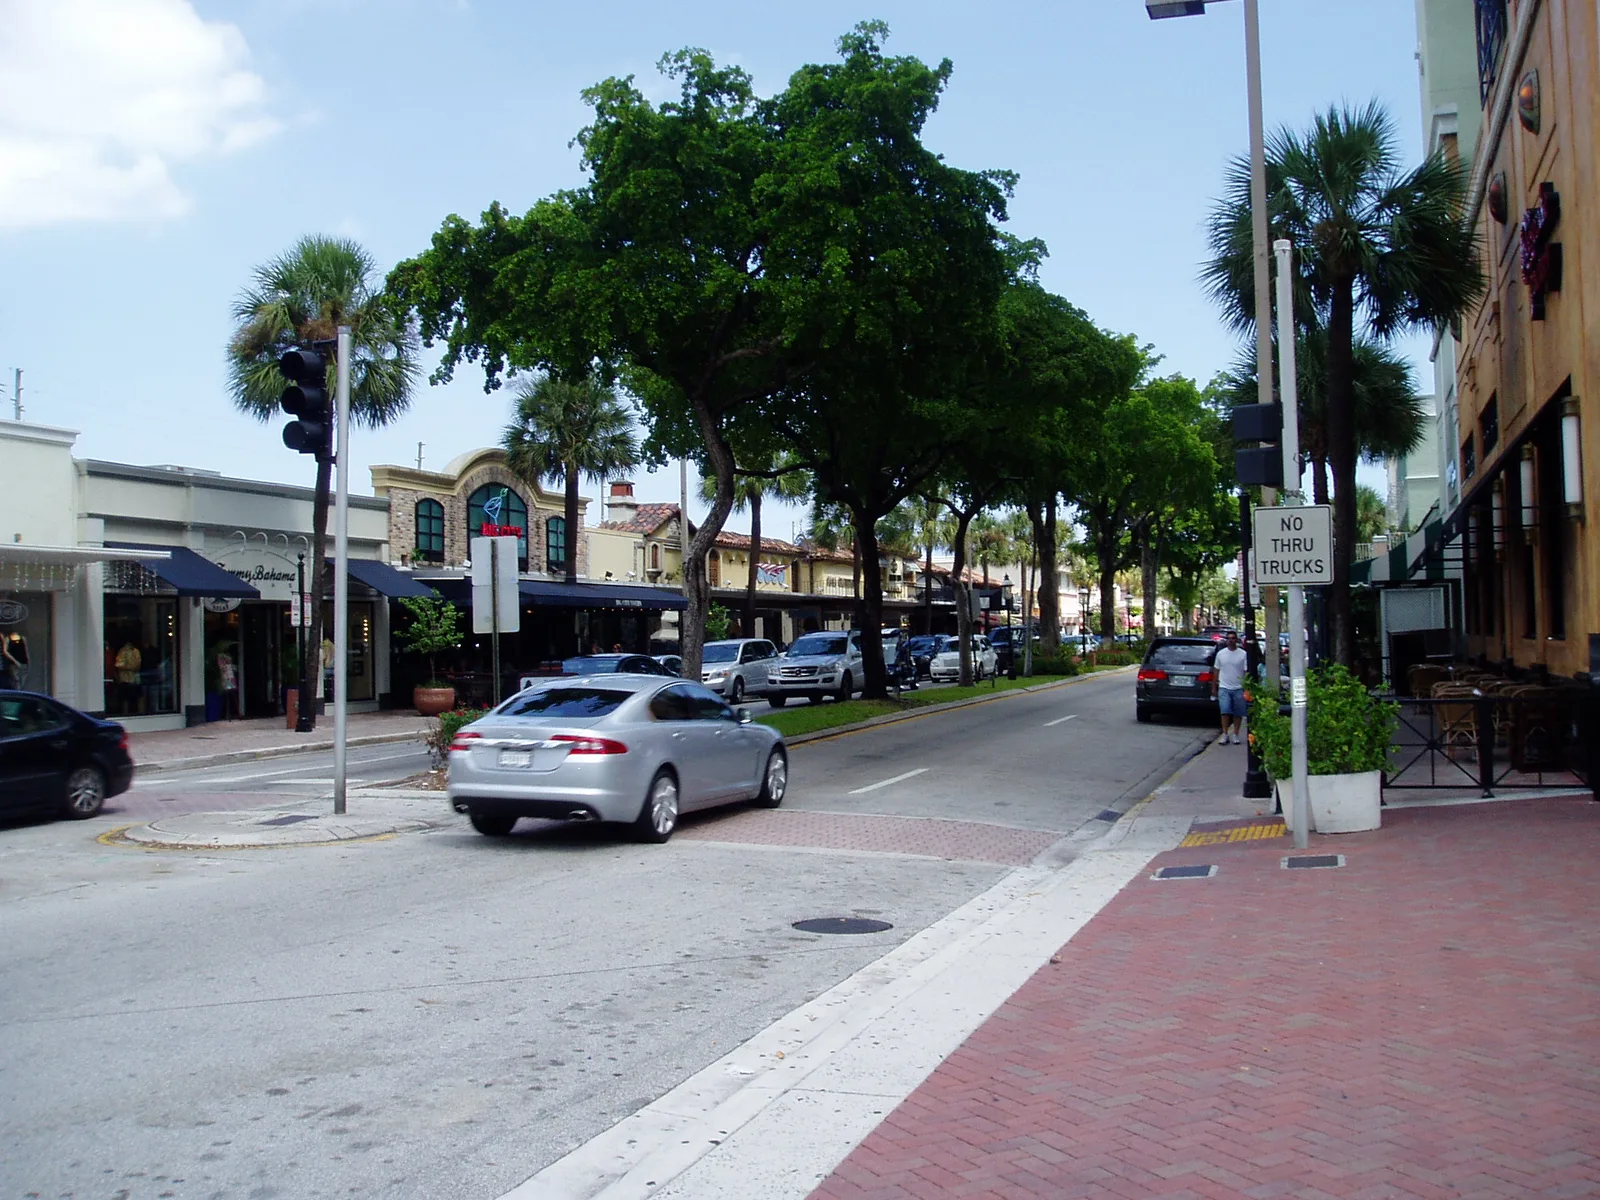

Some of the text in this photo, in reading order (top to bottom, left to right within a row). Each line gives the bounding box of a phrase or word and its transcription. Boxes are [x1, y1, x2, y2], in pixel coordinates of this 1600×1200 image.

[1281, 517, 1303, 531] NO
[1271, 538, 1314, 553] THRU
[252, 565, 296, 581] Bahama
[1260, 559, 1324, 575] TRUCKS
